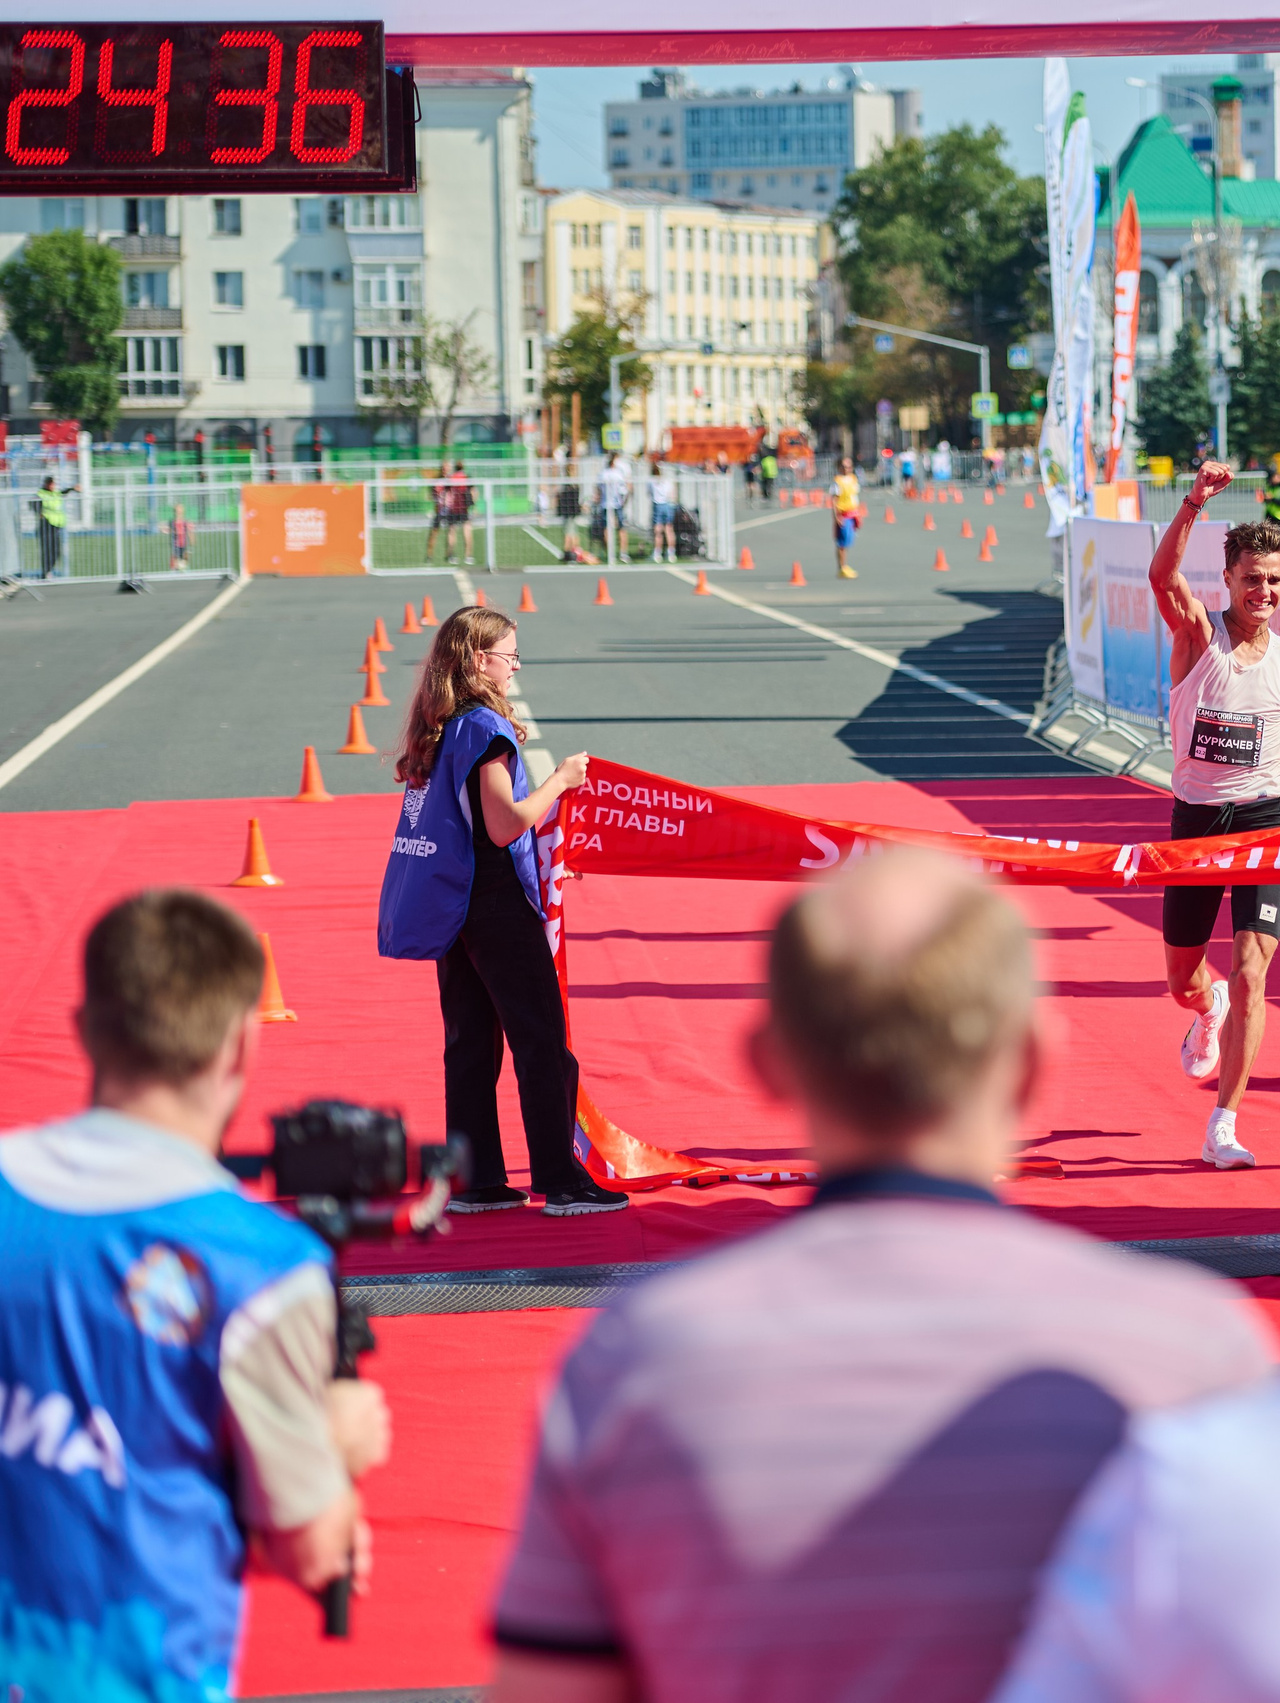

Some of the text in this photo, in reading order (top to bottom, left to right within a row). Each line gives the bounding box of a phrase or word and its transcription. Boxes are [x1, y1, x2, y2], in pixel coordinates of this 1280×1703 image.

[209, 31, 366, 164] 36
[1197, 708, 1233, 720] САМАРСКИЙ
[1197, 734, 1254, 750] КУРКАЧЕВ
[1213, 754, 1228, 763] 706
[594, 806, 685, 837] ГЛАВЫ
